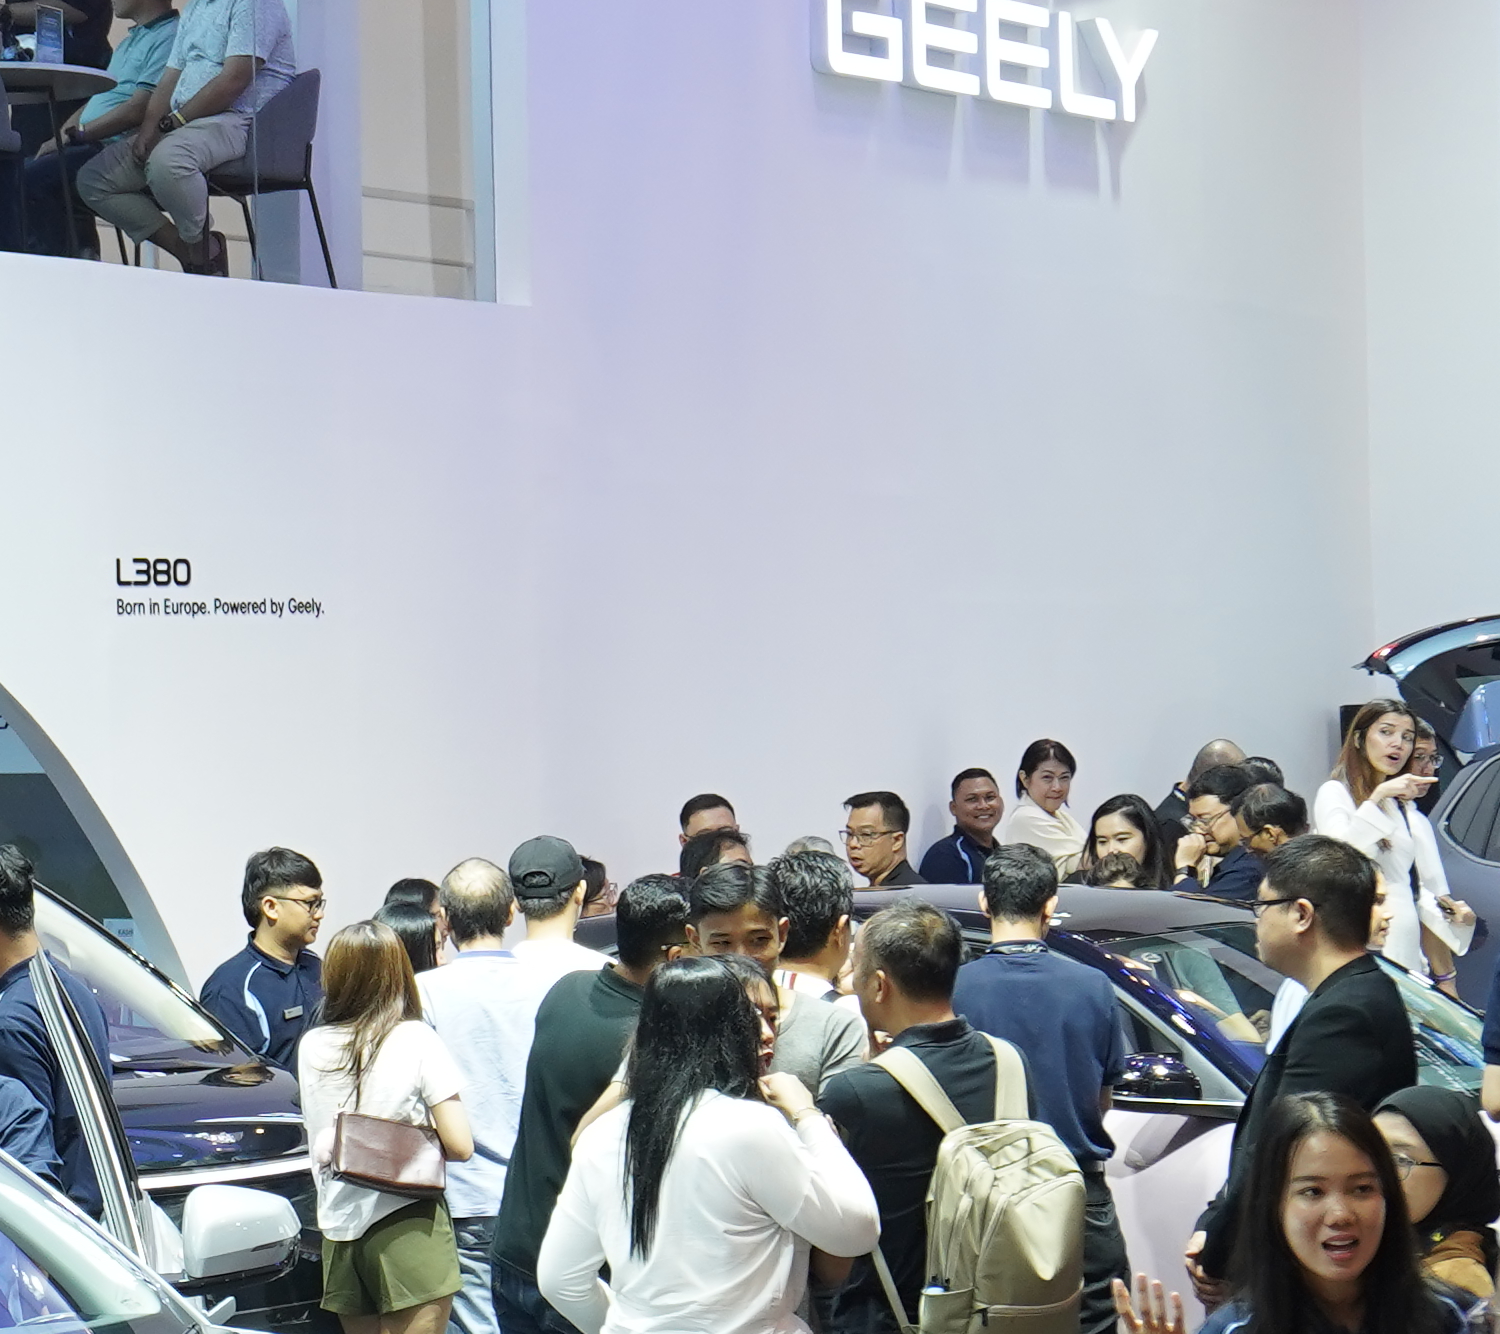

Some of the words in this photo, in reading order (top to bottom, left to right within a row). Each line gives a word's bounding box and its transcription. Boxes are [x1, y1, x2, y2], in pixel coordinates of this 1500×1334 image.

[115, 557, 192, 589] L380
[116, 598, 145, 615] Born
[149, 598, 160, 615] in
[164, 598, 210, 619] Europe.
[214, 597, 266, 616] Powered
[270, 597, 284, 618] by
[288, 597, 325, 618] Geely.
